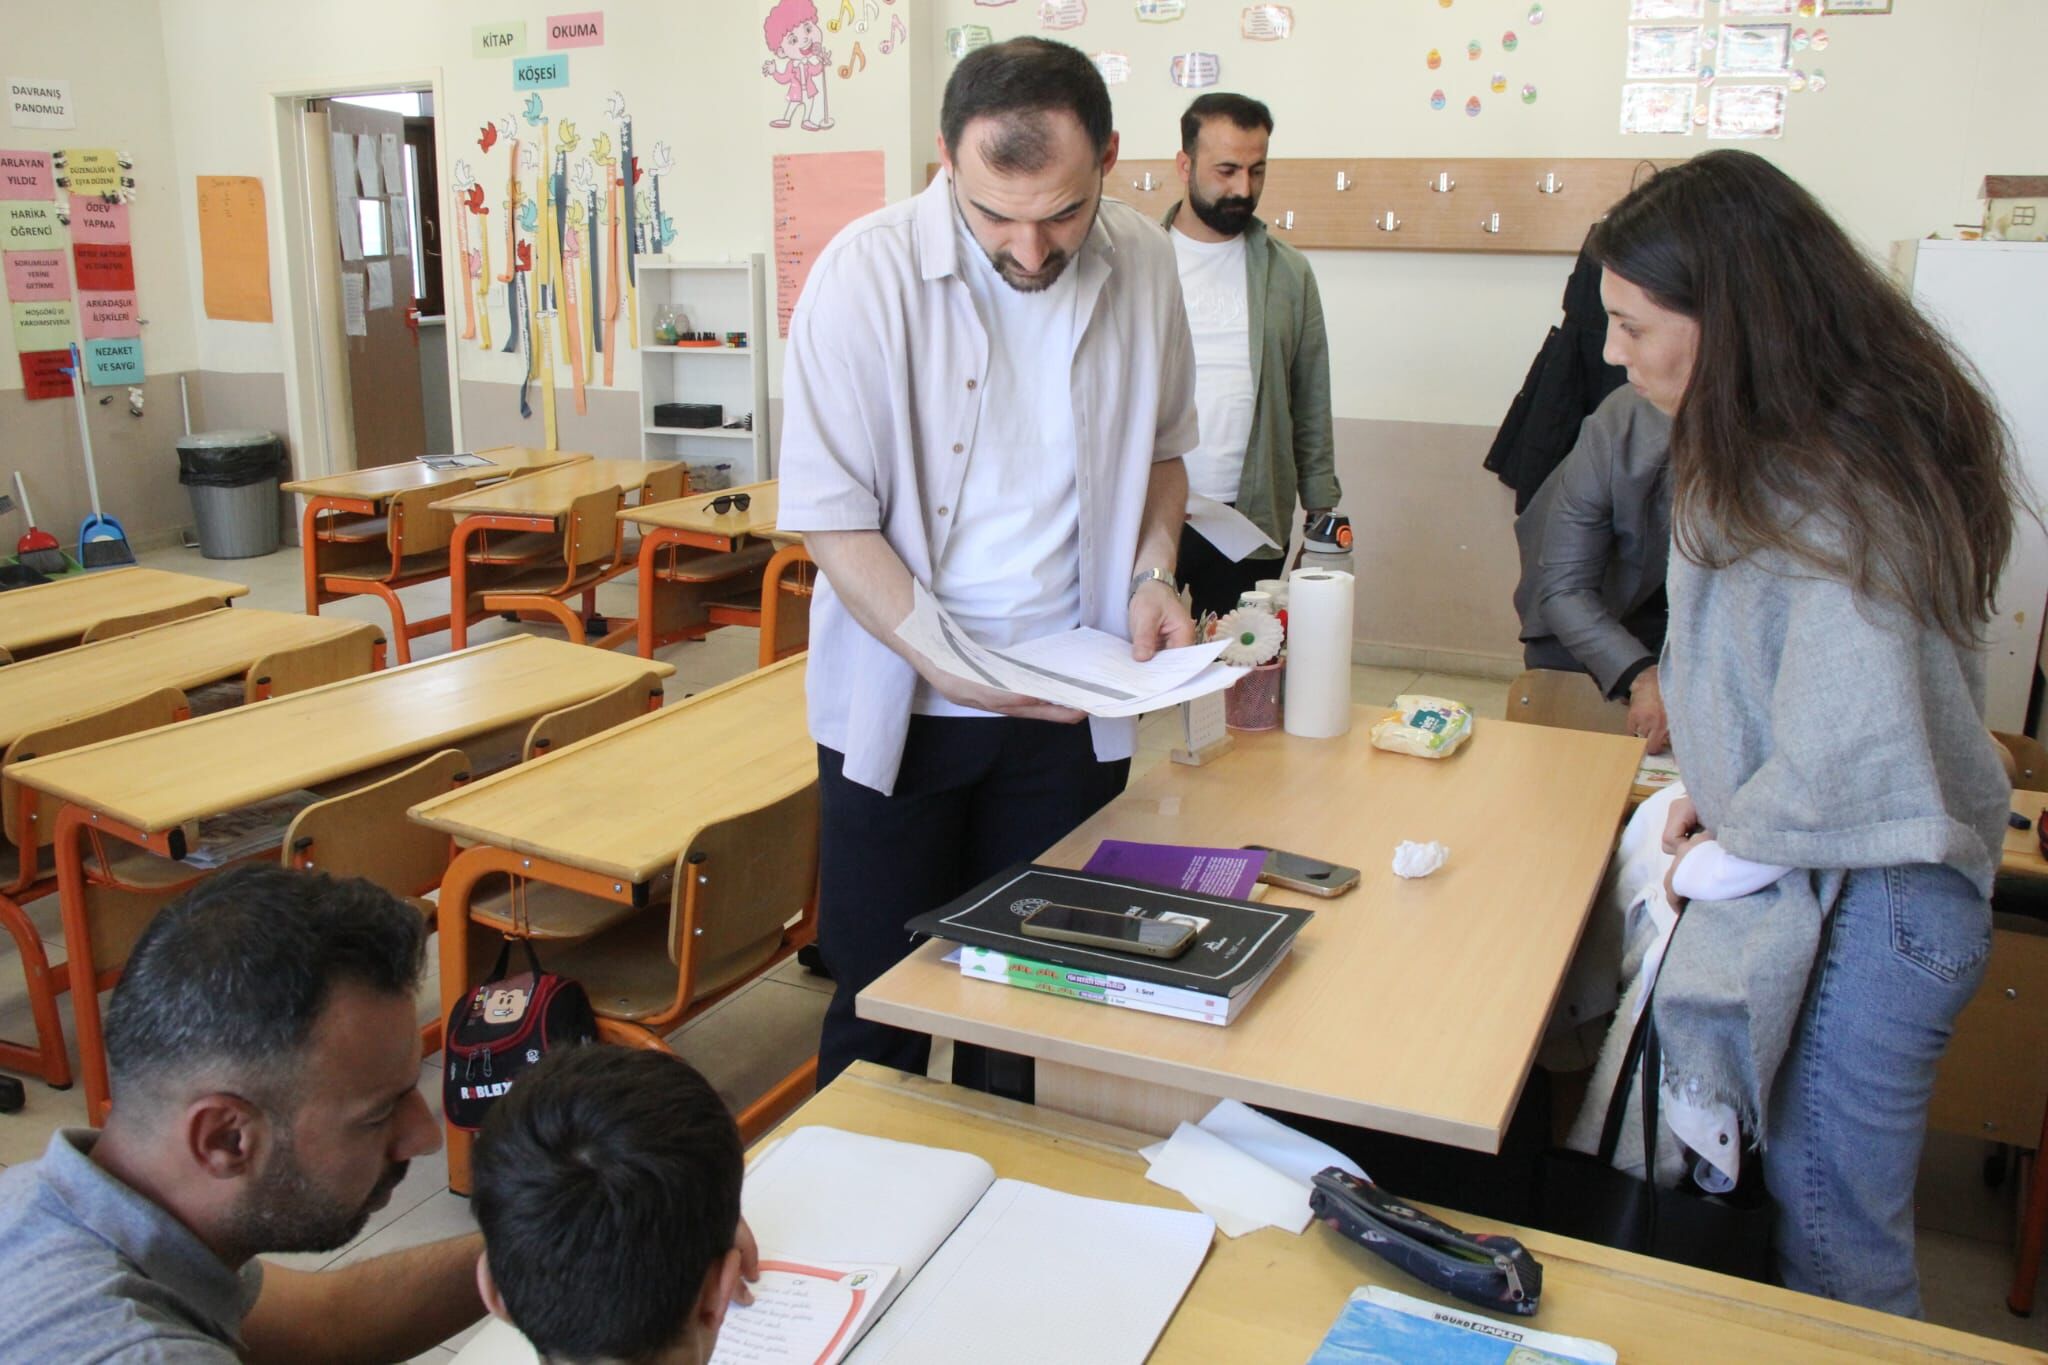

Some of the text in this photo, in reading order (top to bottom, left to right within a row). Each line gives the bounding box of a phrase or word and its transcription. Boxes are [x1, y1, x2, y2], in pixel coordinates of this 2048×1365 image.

[552, 23, 598, 39] OKUMA
[482, 32, 514, 48] KİTAP
[518, 64, 556, 83] KÖŞESİ
[12, 85, 61, 99] DAVRANIŞ
[15, 103, 65, 115] PANOMUZ
[8, 176, 37, 186] YILDIZ
[11, 207, 47, 219] HARİKA
[86, 202, 111, 213] ÖDEV
[83, 218, 116, 229] YAPMA
[10, 225, 53, 237] ÖĞRENCİ
[86, 300, 133, 309] ARKADAŞLIK
[93, 311, 130, 324] İLİŞKİLERİ
[95, 346, 133, 356] NEZAKET
[97, 362, 136, 372] VE SAYGI
[461, 1081, 513, 1100] ROBLOX
